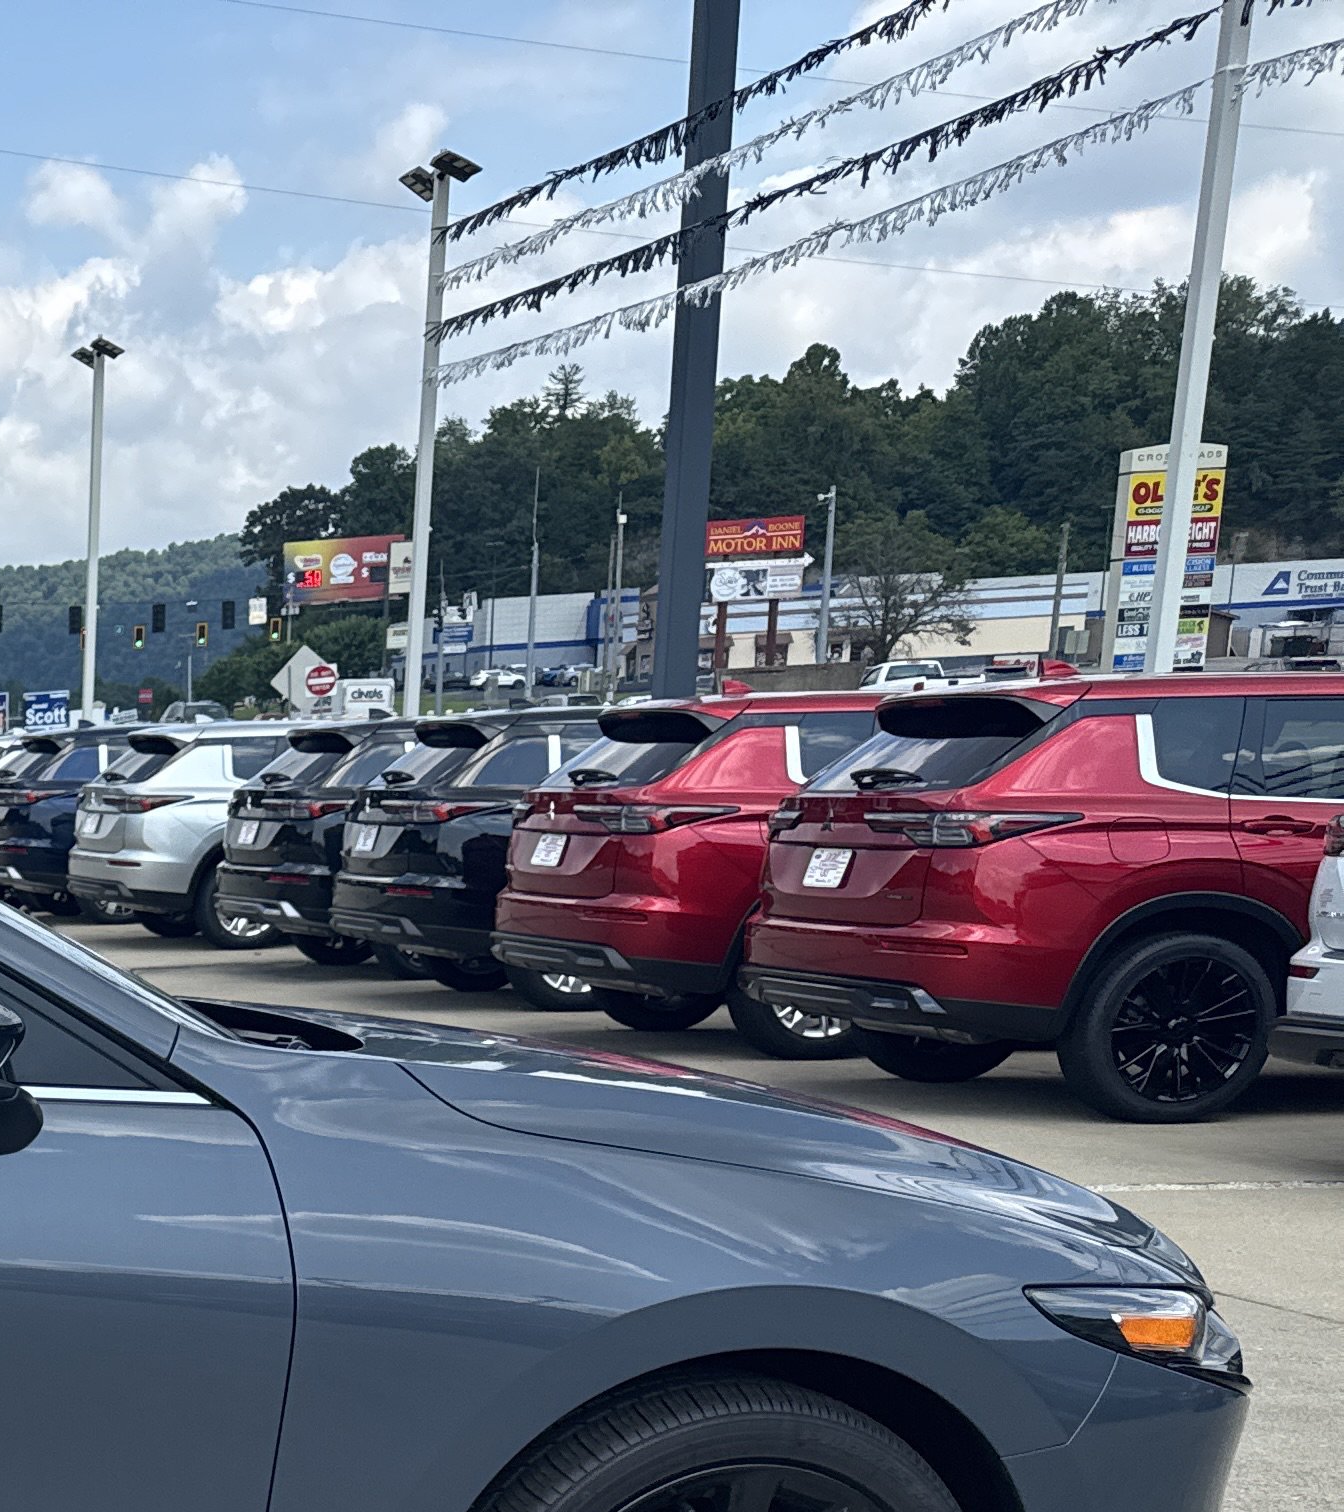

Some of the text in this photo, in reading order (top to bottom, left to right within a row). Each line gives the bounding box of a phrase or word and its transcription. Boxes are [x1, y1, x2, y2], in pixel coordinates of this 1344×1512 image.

[1137, 450, 1223, 462] CROSADS
[1132, 473, 1221, 505] OLE'S
[710, 521, 801, 536] DANIEL BOONE
[1127, 521, 1217, 543] HARBO EIGHT
[708, 534, 801, 554] MOTOR INN
[1297, 570, 1344, 581] Commu
[1297, 581, 1344, 594] Trust Ba
[25, 707, 67, 725] Scott
